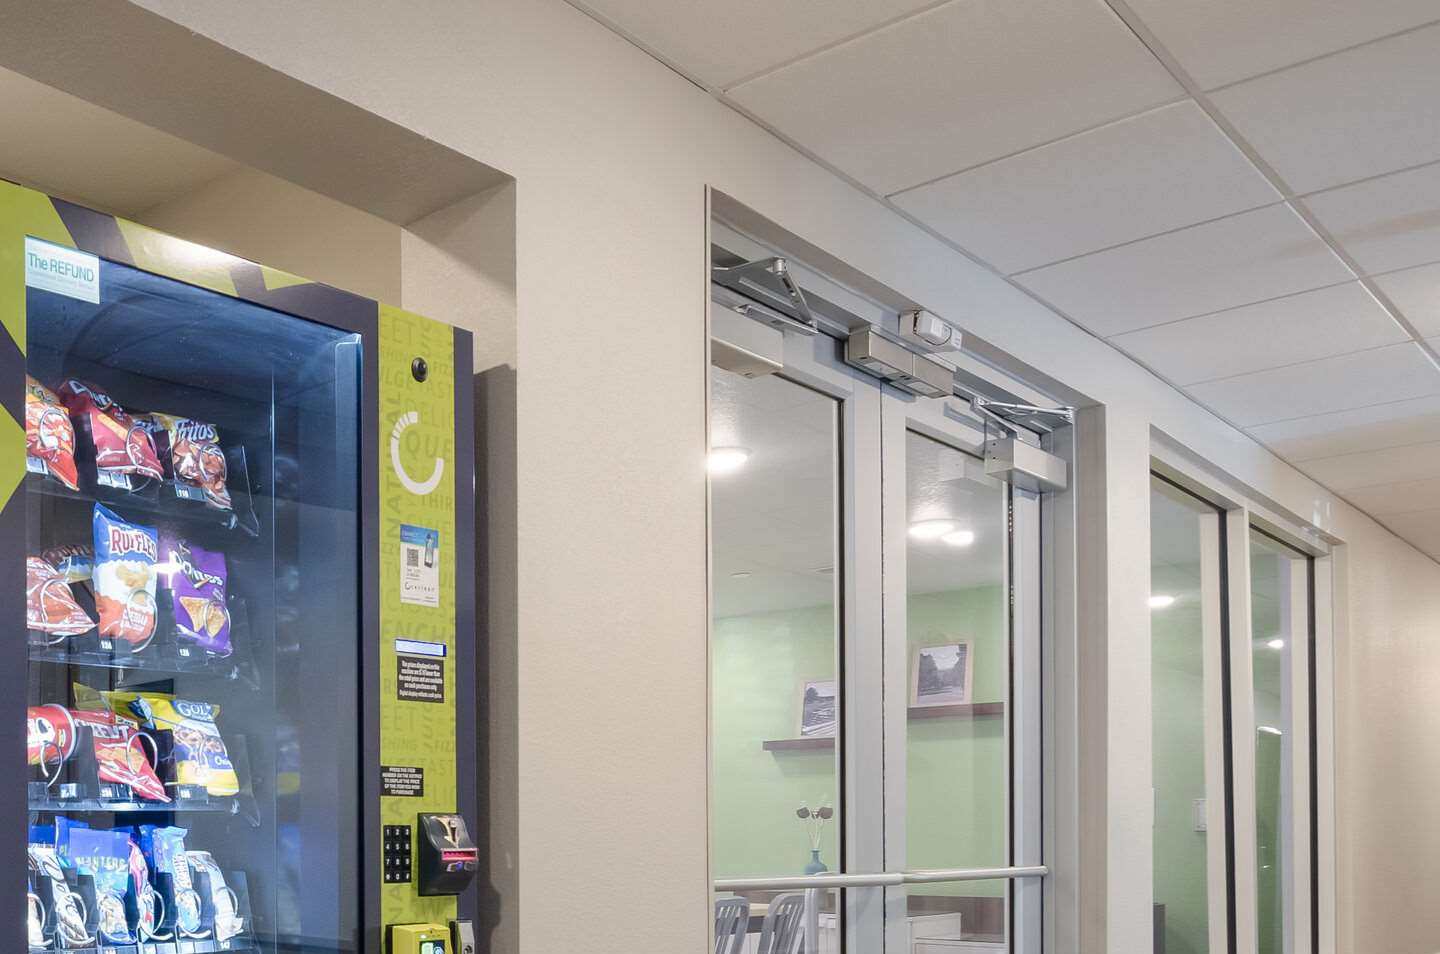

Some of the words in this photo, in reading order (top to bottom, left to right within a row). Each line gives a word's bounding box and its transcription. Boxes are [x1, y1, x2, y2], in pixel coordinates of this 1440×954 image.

[28, 252, 48, 270] The
[49, 258, 95, 282] REFUND
[176, 419, 216, 441] Fritos
